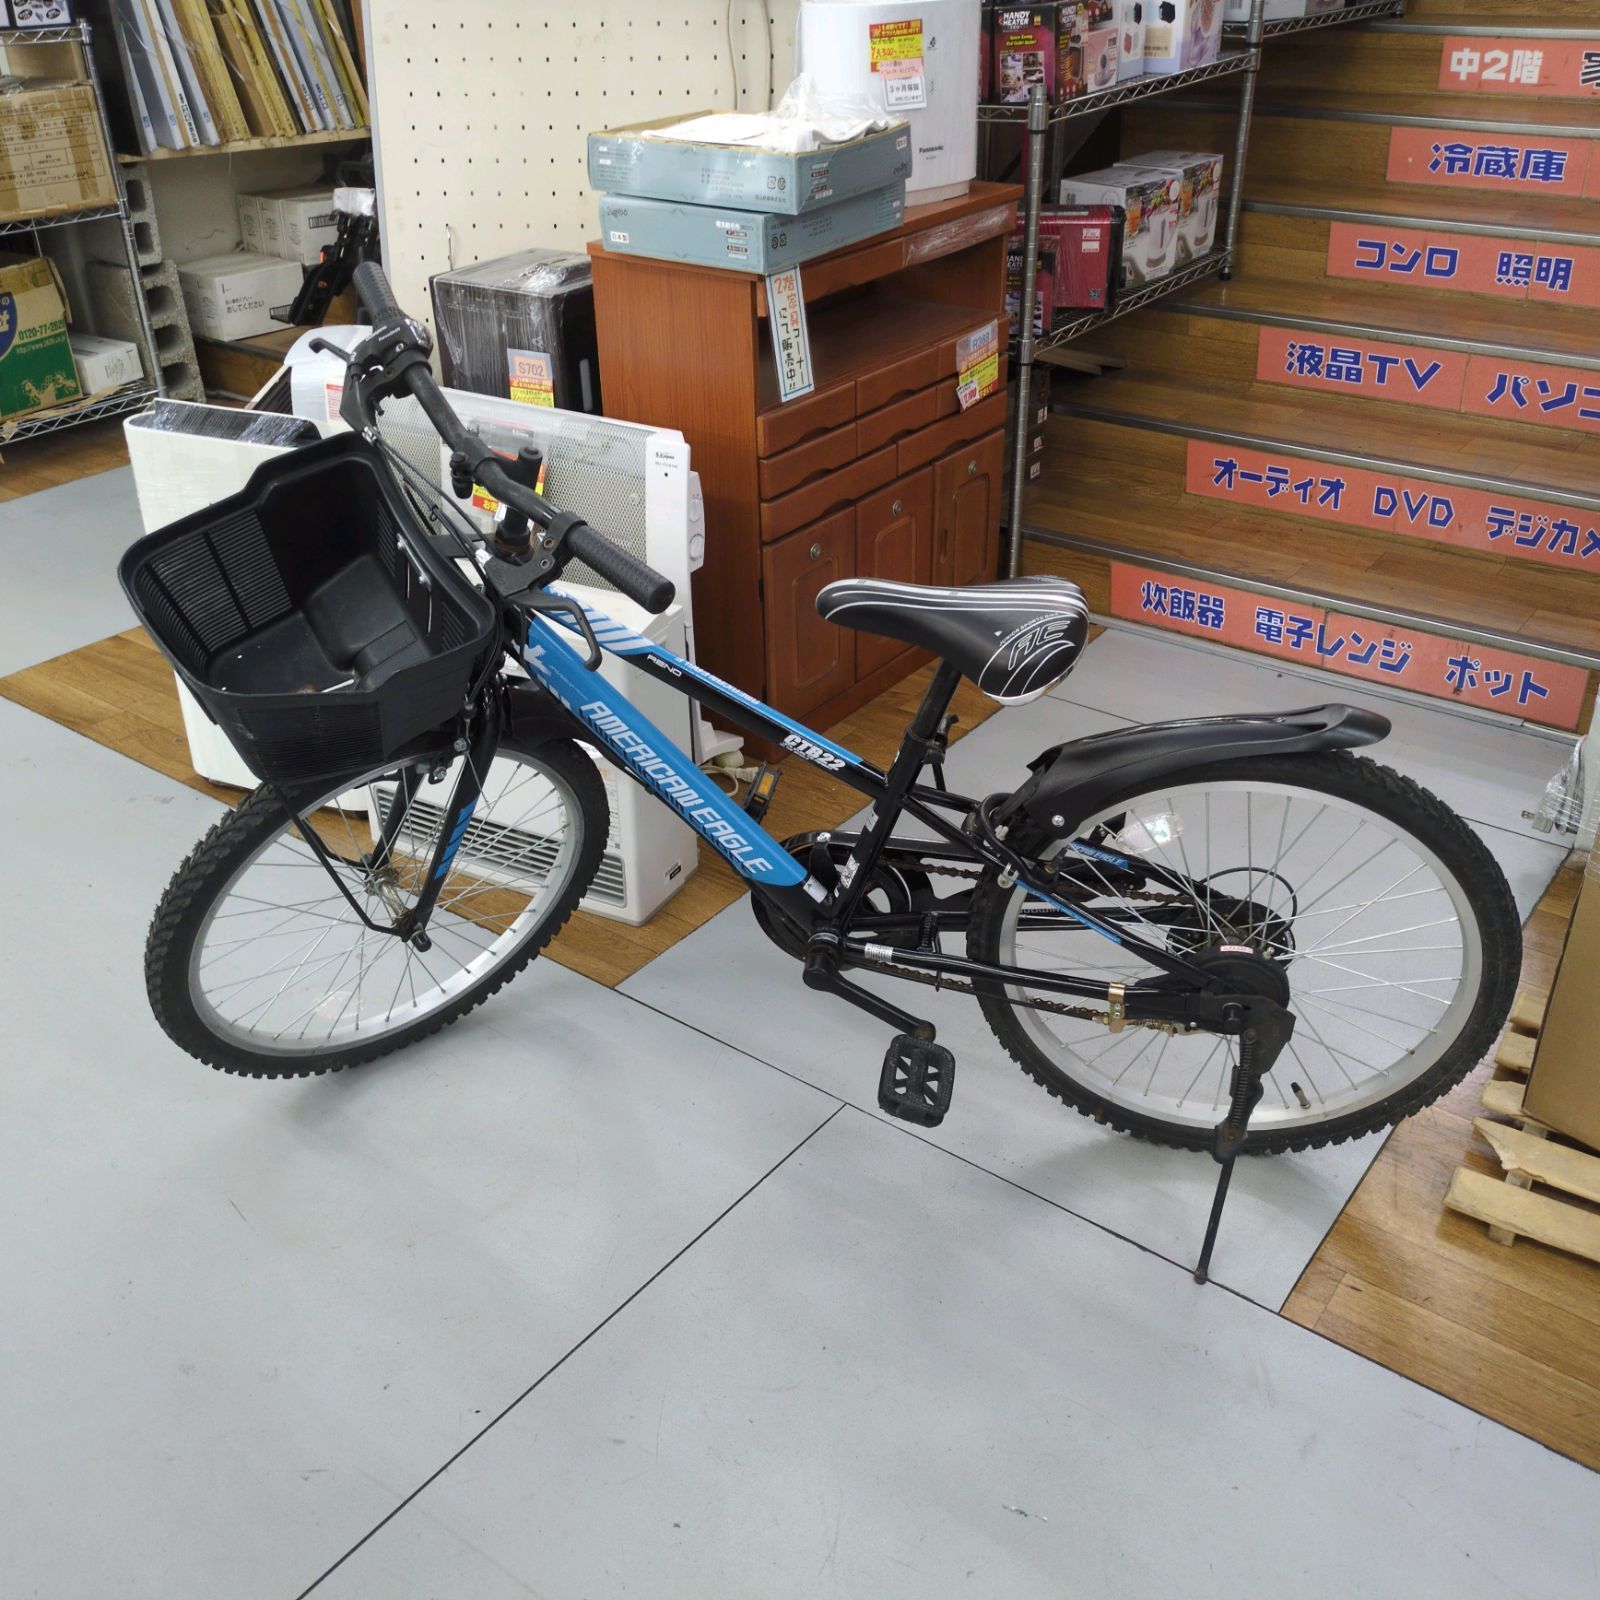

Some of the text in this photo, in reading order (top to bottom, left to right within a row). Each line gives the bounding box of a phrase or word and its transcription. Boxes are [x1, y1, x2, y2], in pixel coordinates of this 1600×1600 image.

[1002, 18, 1030, 26] HEATER
[1003, 10, 1031, 20] HANDY
[1450, 48, 1543, 84] 中2階
[918, 144, 944, 155] Panasonic
[1429, 142, 1568, 182] 冷蔵庫
[1354, 240, 1574, 291] コンロ 照明
[518, 361, 545, 378] S702
[1285, 342, 1443, 391] 液晶TV
[1213, 457, 1346, 511] オーディオ
[1373, 486, 1454, 530] DVD
[1141, 581, 1550, 704] 炊飯器 電子レンジ ポット
[646, 653, 682, 678] RENO
[783, 734, 846, 772] CTB22
[579, 700, 704, 809] AMERICAN
[690, 805, 774, 875] EAGLE
